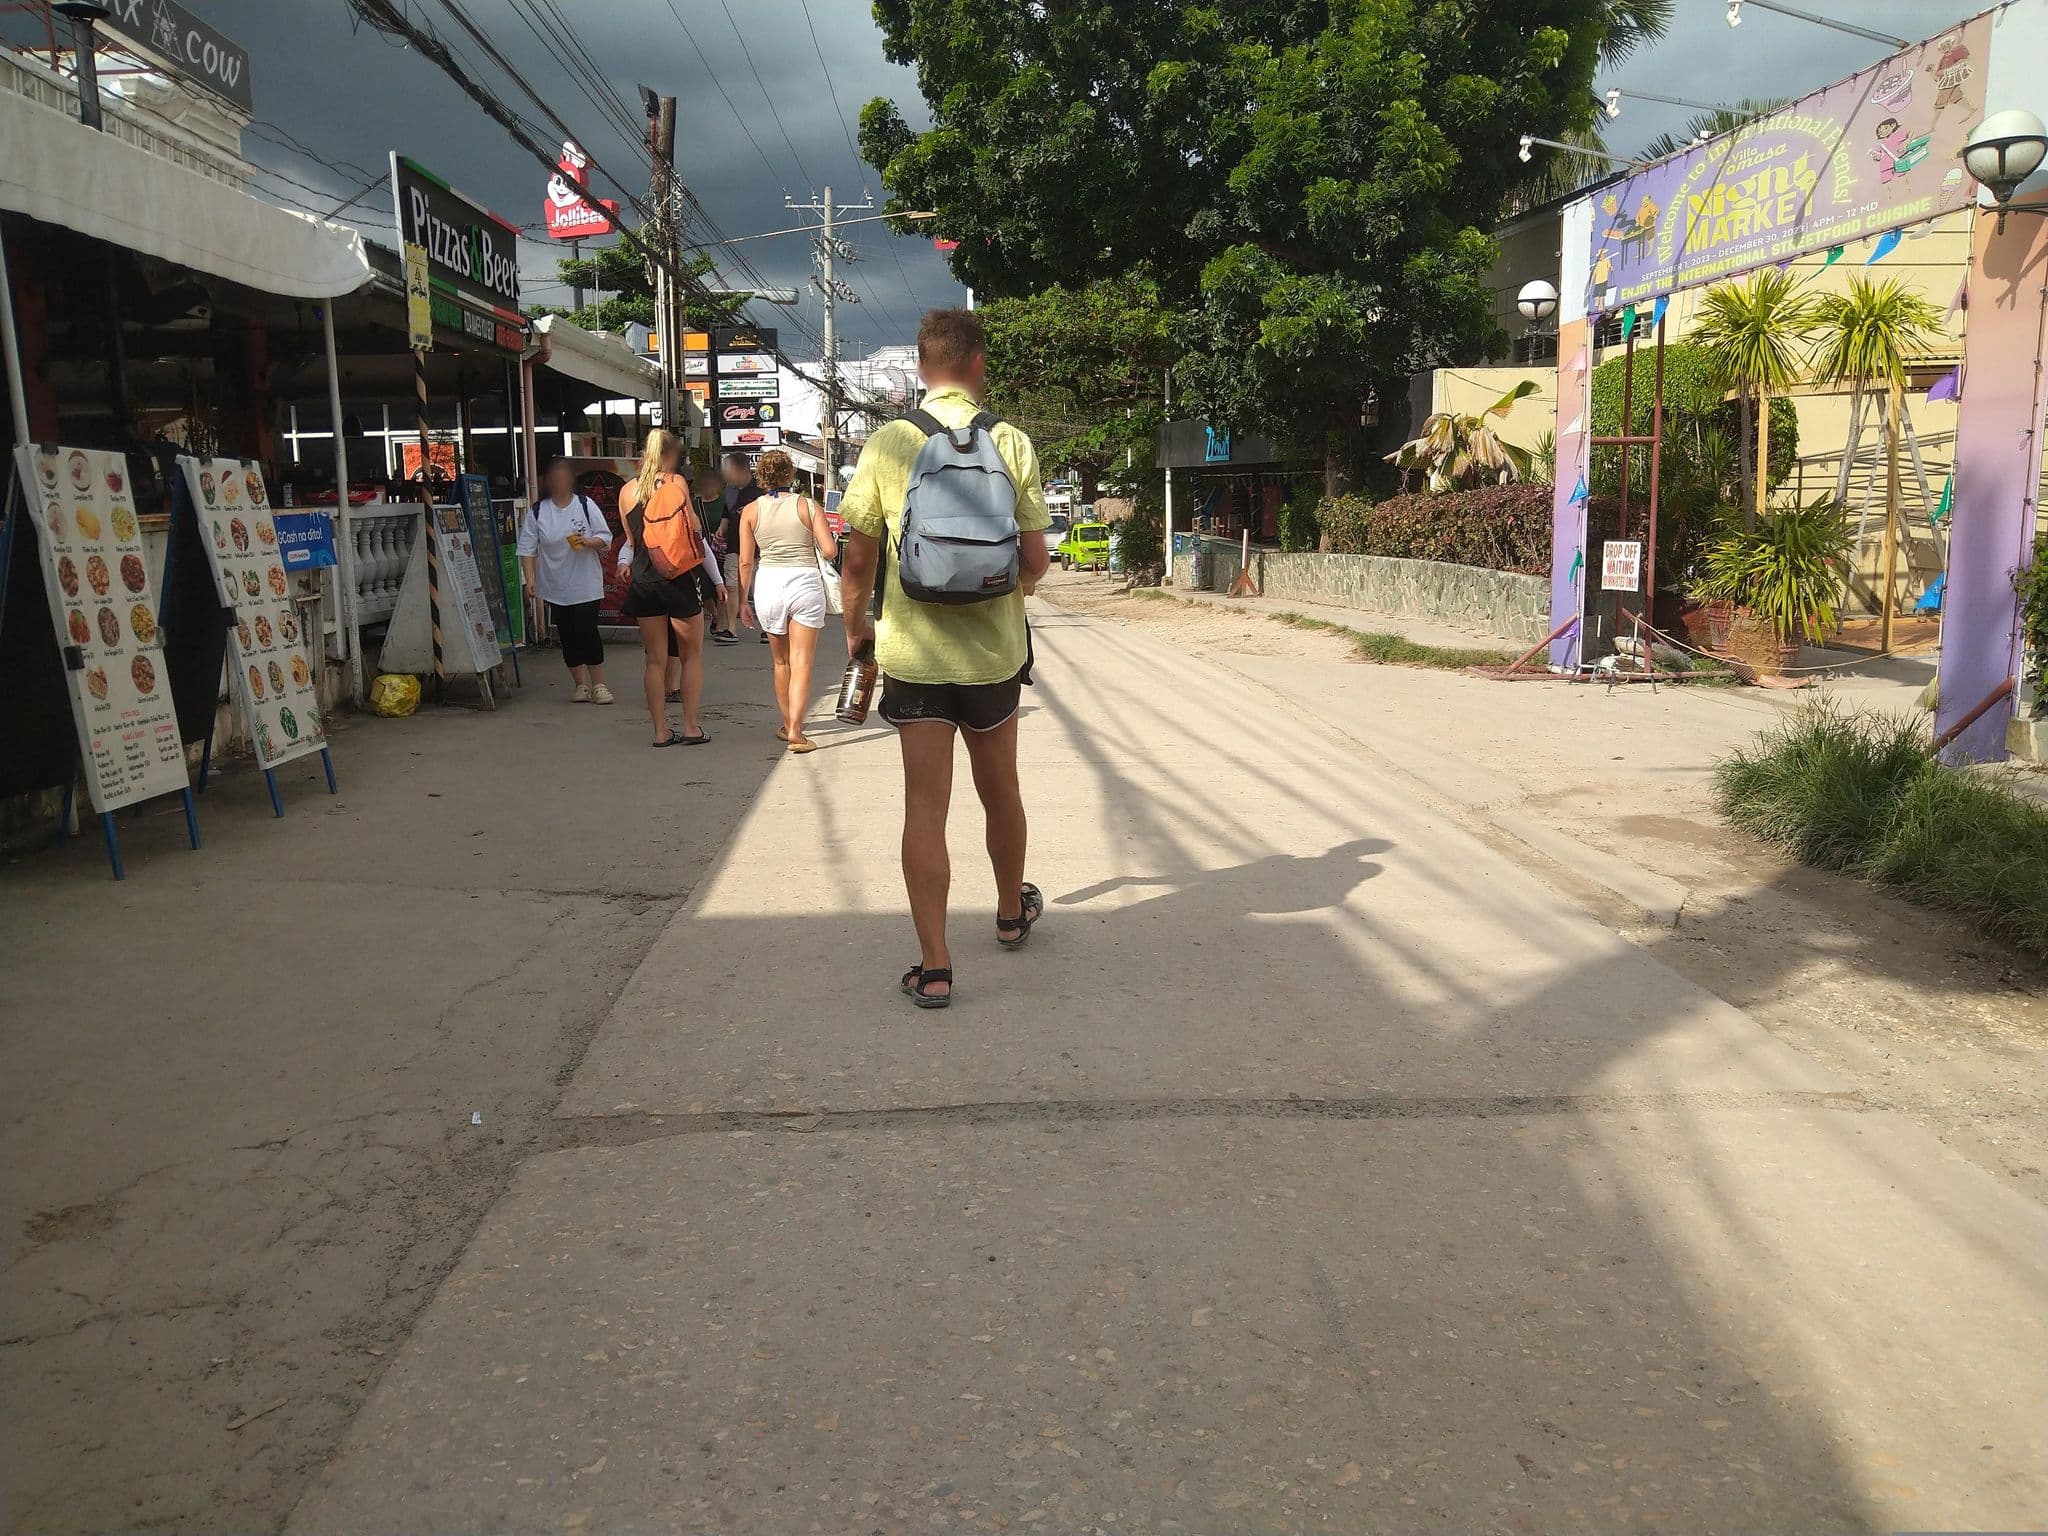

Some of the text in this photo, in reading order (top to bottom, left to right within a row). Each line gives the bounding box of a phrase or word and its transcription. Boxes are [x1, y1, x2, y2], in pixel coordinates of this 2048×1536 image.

[186, 30, 240, 88] COW
[1658, 183, 1691, 265] Welcome
[1688, 163, 1705, 181] to
[1706, 115, 1834, 162] International
[1688, 150, 1816, 219] Night
[1622, 197, 1932, 300] ENJOY THE INTERNATIONAL STREETFOOD CUISINE
[1641, 262, 1684, 282] SEPTEMBER
[1691, 255, 1710, 266] 2023
[1719, 239, 1763, 257] DECEMBER
[1766, 234, 1779, 244] 30,
[1813, 217, 1835, 228] 4PM
[1846, 207, 1857, 218] 12
[1860, 202, 1879, 213] MD
[1686, 190, 1815, 255] MARKET
[277, 528, 323, 545] GCash na dito!
[1606, 543, 1637, 558] DROP OFF
[1607, 560, 1634, 575] WAITING
